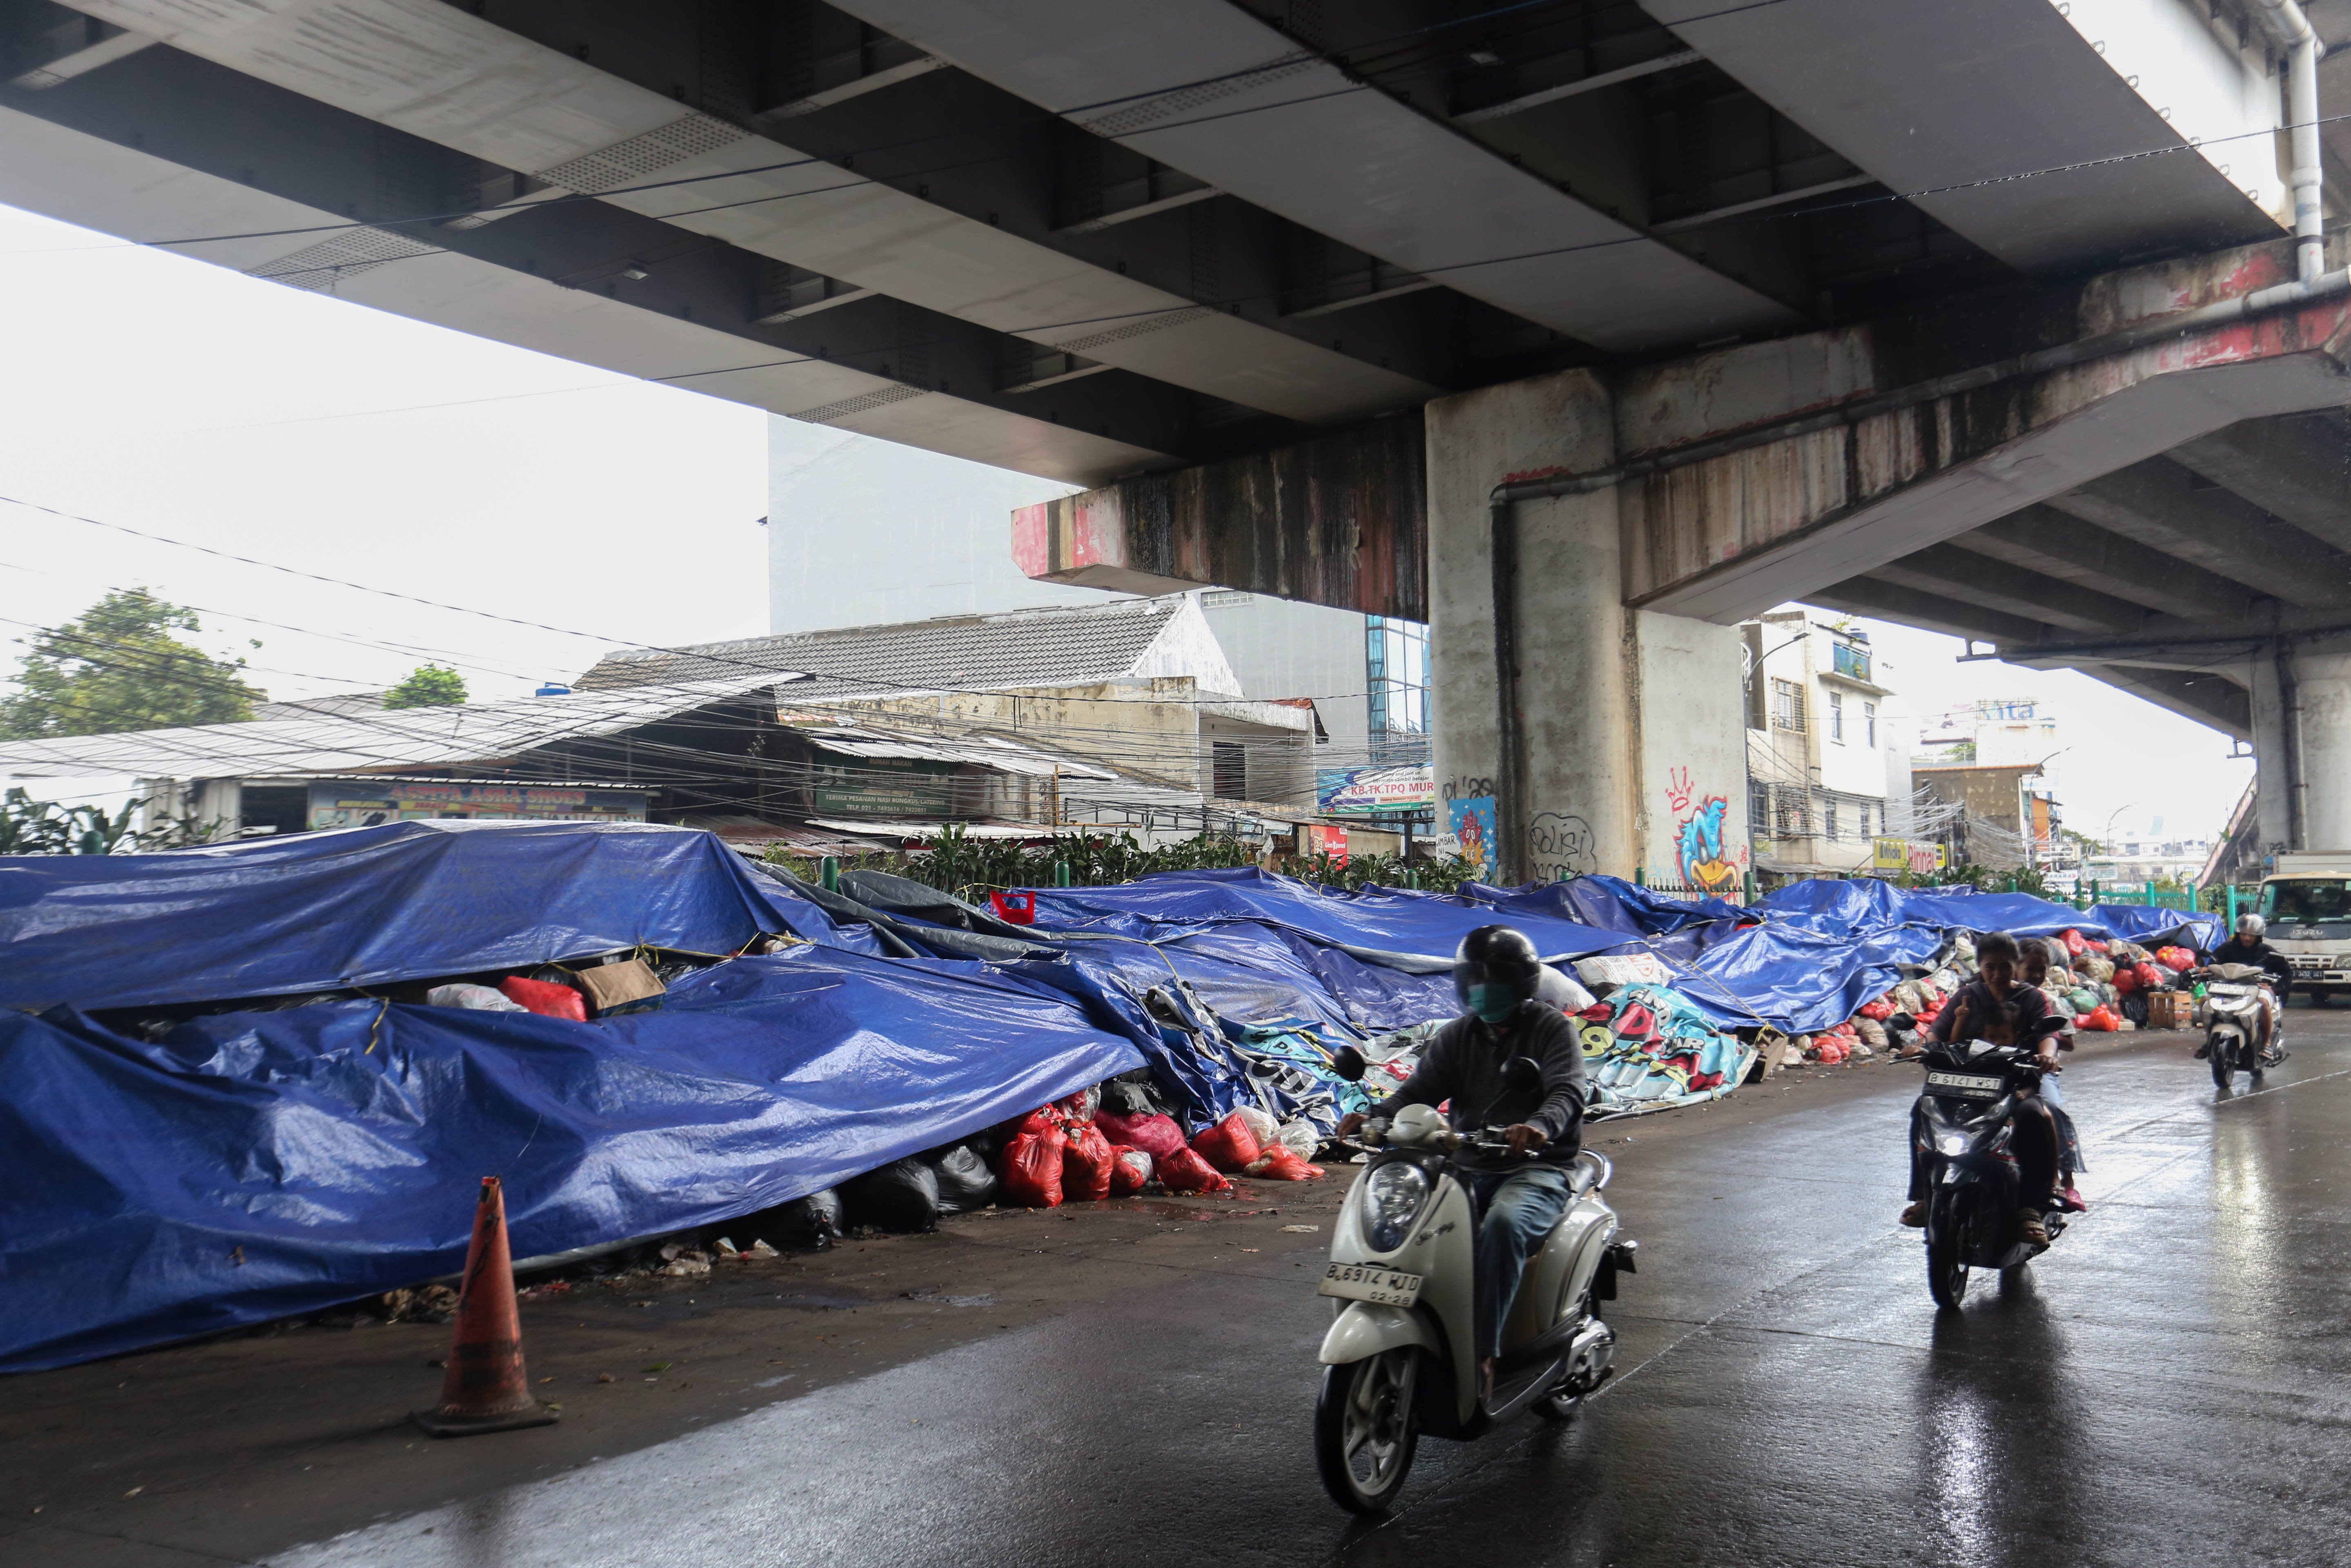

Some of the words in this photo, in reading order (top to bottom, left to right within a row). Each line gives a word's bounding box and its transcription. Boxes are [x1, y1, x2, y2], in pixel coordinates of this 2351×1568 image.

[869, 758, 890, 766] RUMAH
[891, 760, 912, 768] MAKAN
[1351, 784, 1406, 795] KB.TK.TPQ
[470, 787, 523, 803] ASRA
[526, 789, 586, 804] SHOES
[1436, 836, 1455, 846] AMBAR
[1930, 1074, 1938, 1082] B
[1326, 1265, 1337, 1278] B
[1343, 1267, 1382, 1285] 6914
